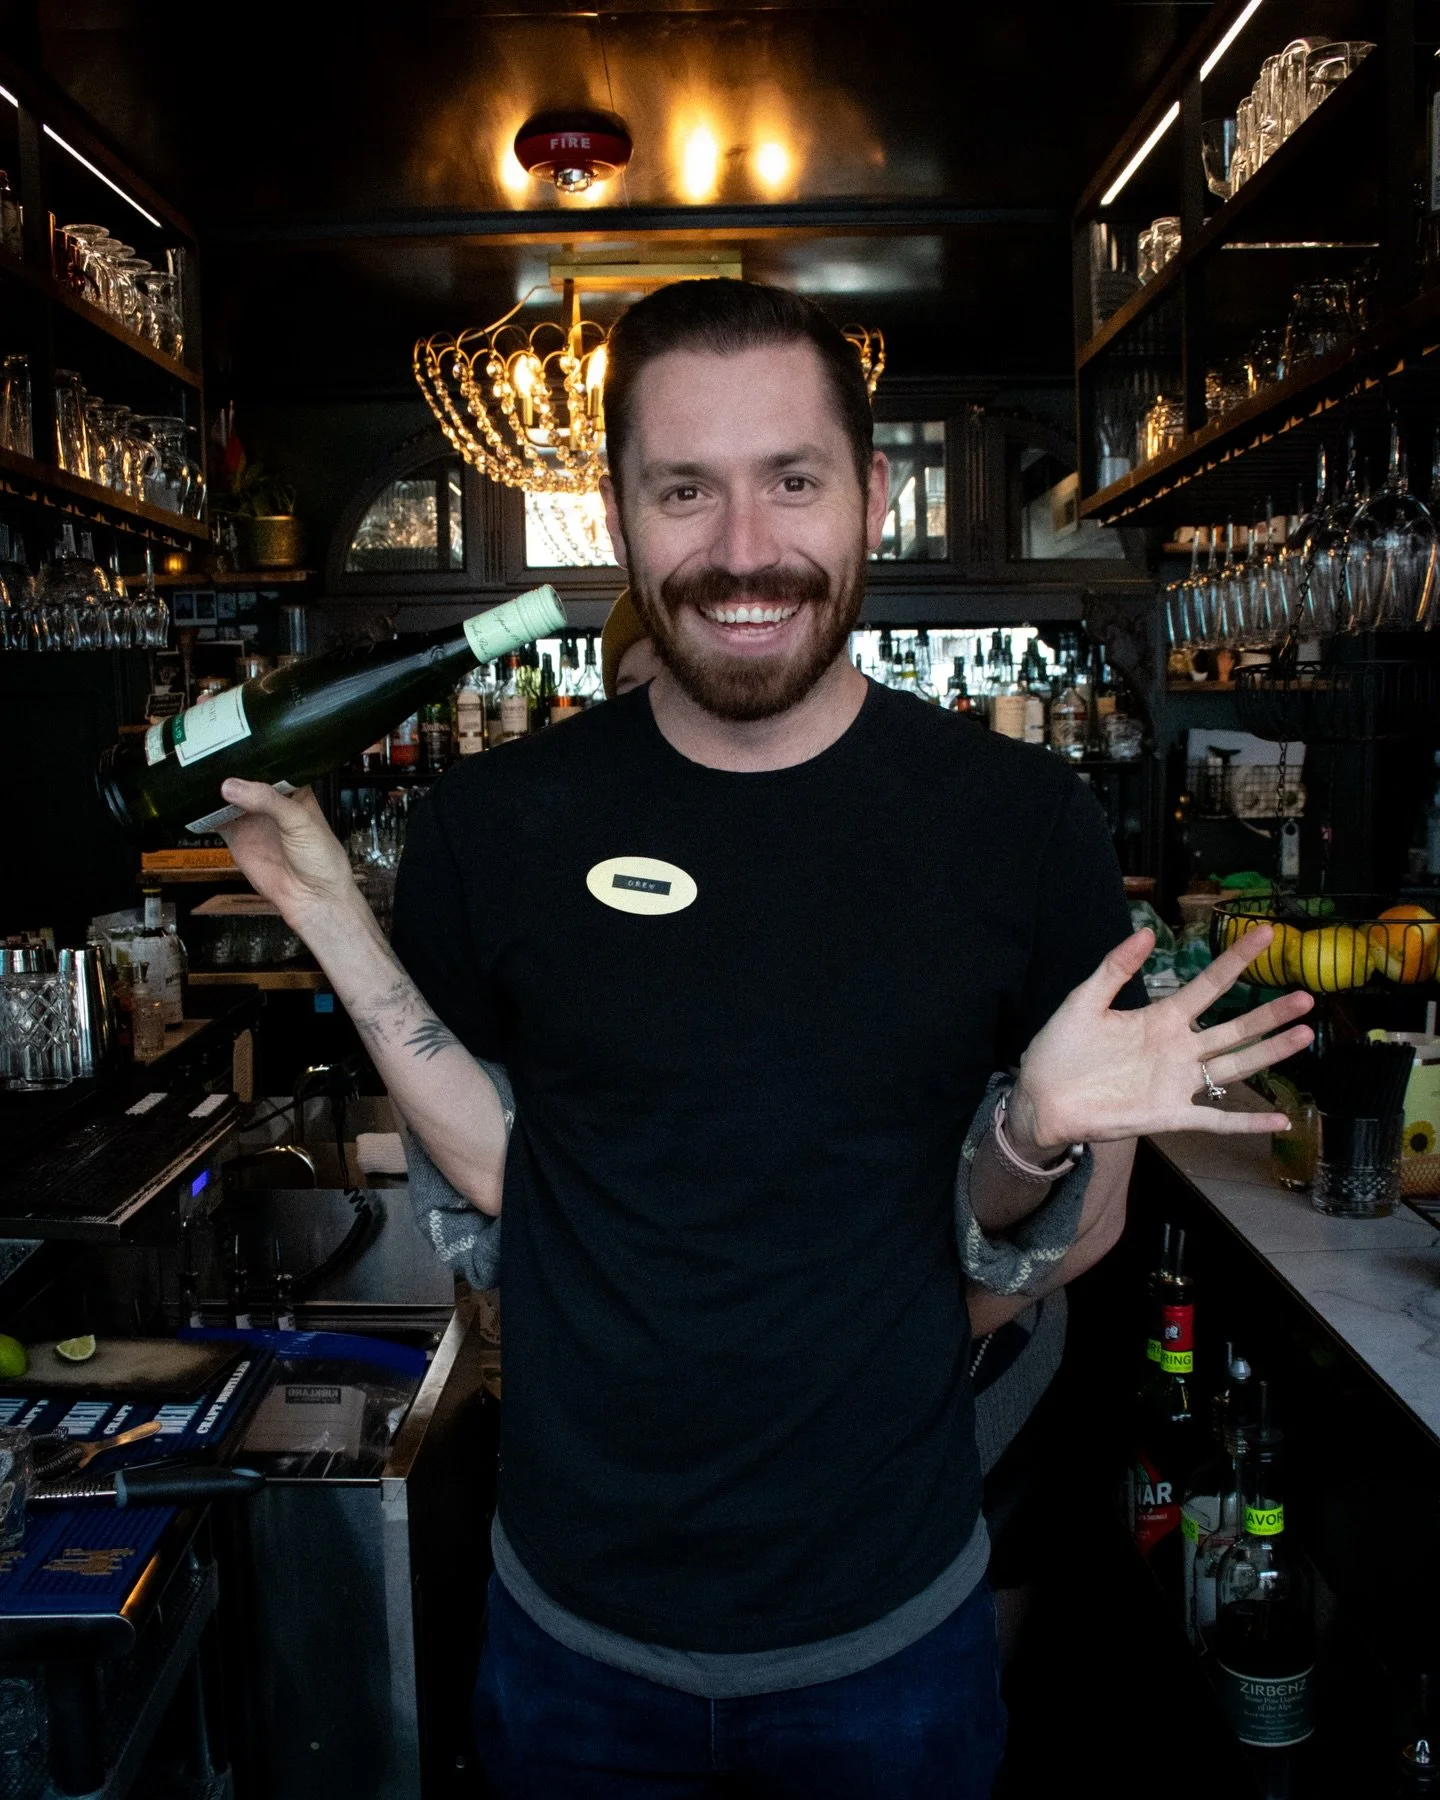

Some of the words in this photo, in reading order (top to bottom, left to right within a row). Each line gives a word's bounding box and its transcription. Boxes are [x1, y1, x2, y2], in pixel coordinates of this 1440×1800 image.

[549, 137, 591, 150] FIRE
[626, 879, 656, 891] DREW
[1240, 1678, 1307, 1697] ZIRBENZ
